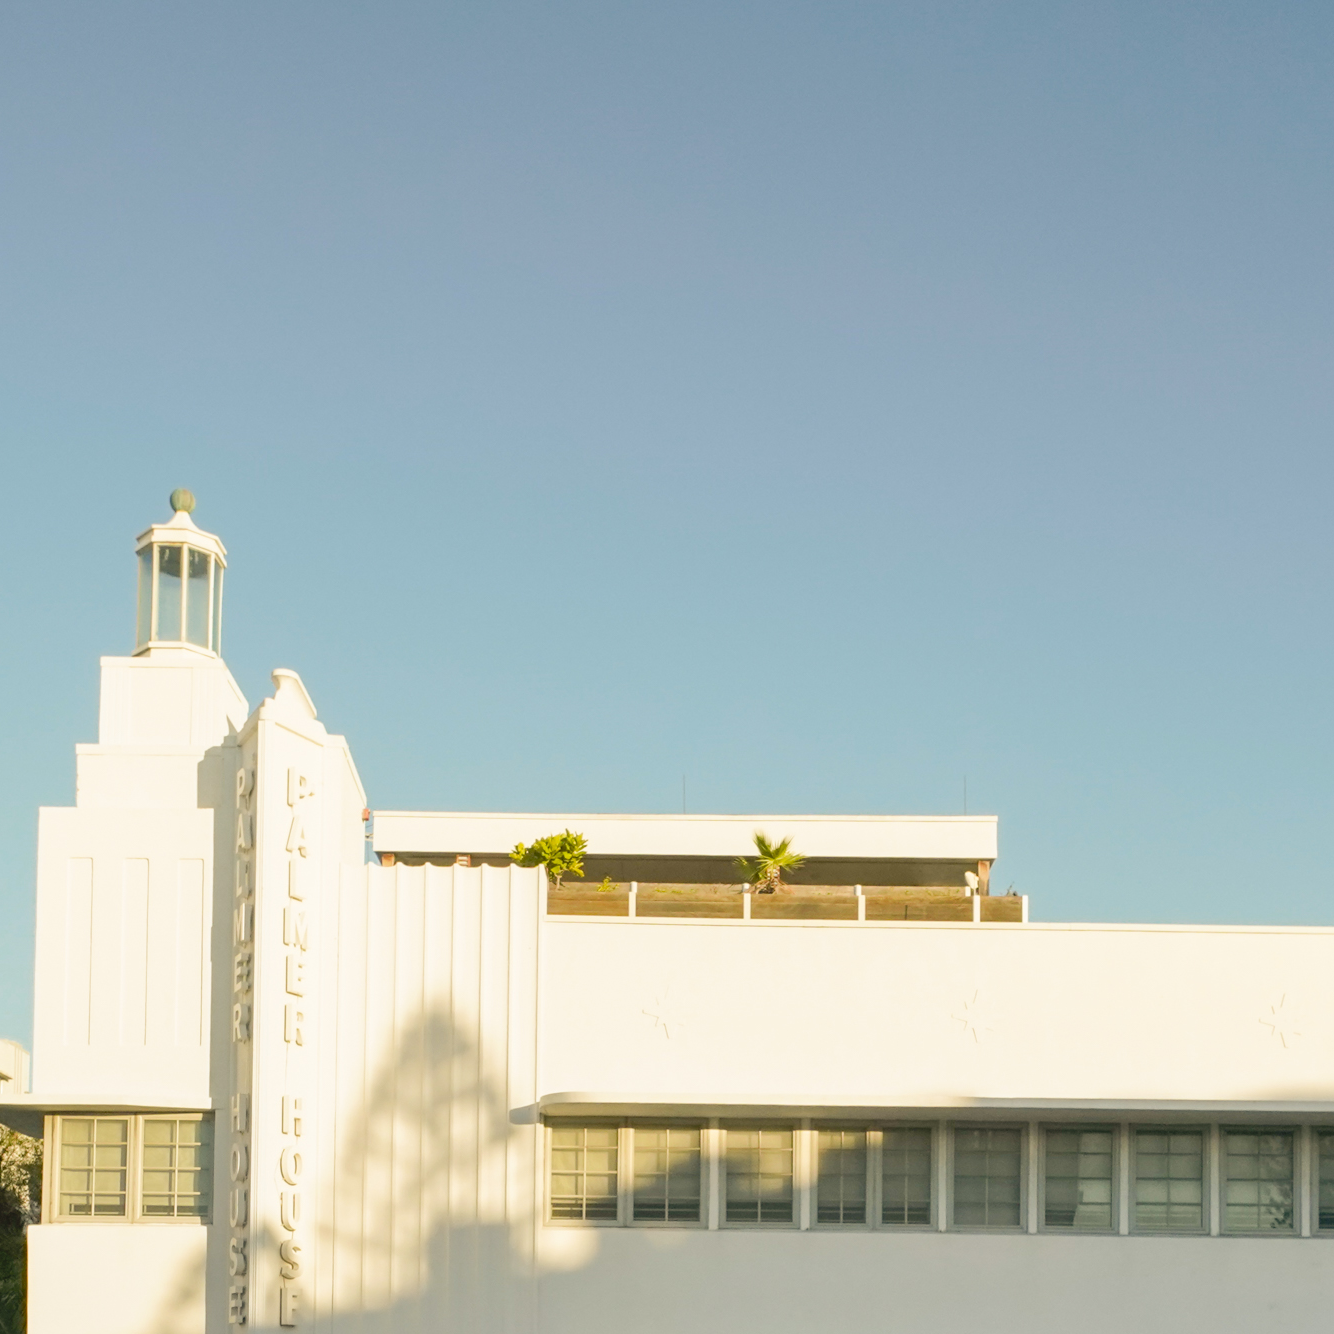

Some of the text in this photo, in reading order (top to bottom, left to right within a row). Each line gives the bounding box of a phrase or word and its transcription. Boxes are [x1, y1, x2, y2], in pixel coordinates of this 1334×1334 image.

[228, 768, 253, 1326] PALMER HOUSE
[279, 766, 312, 1328] PALMER HOUSE
